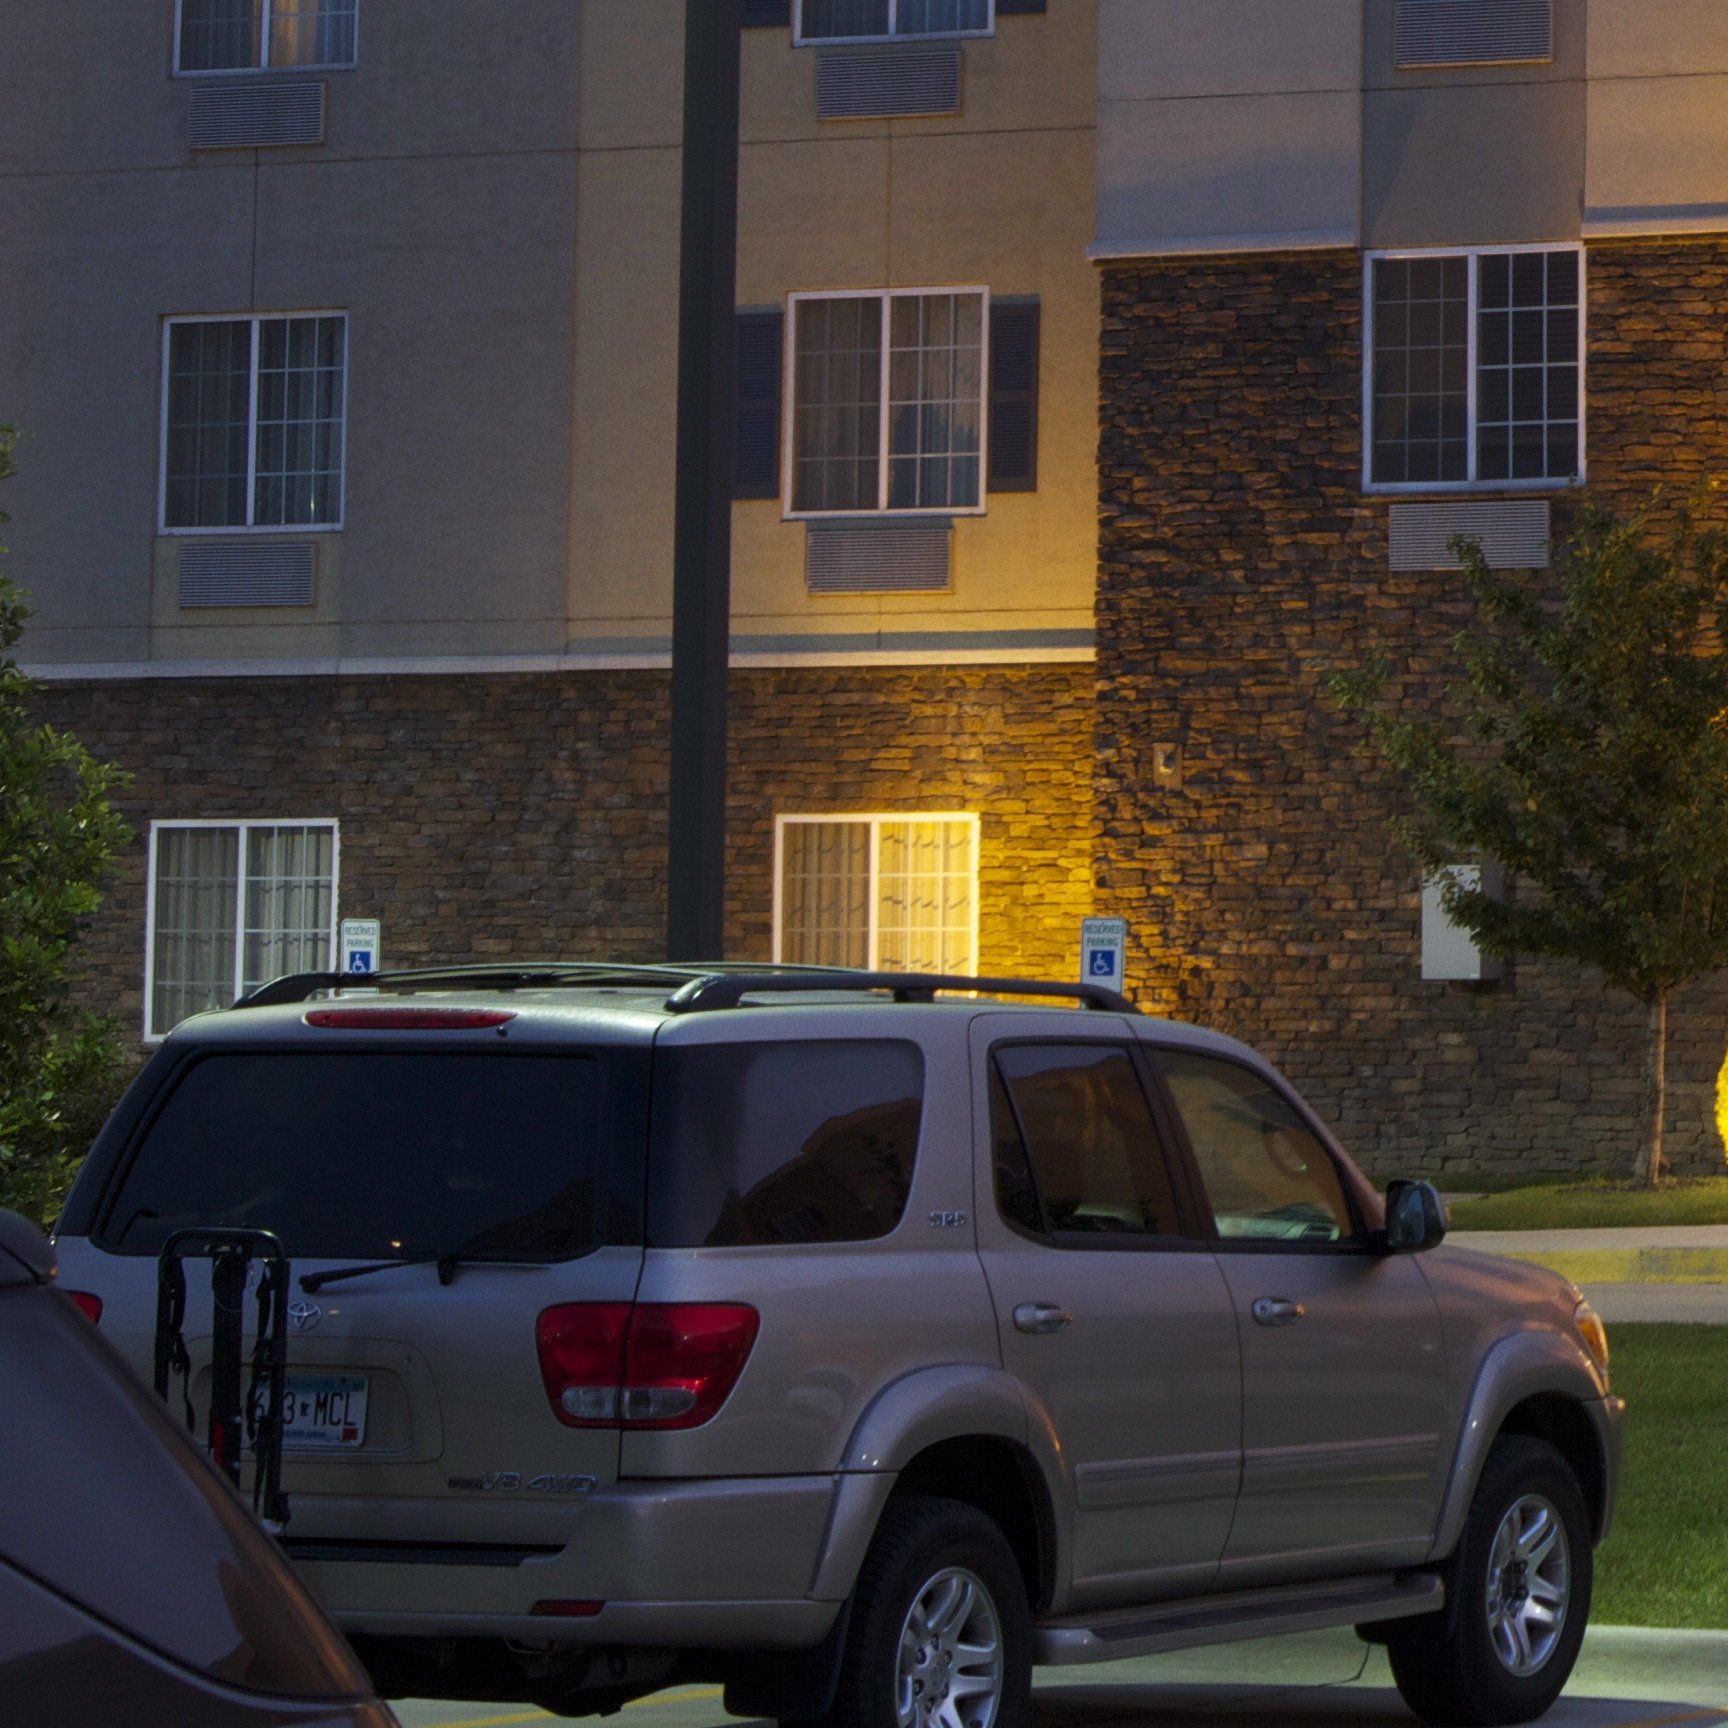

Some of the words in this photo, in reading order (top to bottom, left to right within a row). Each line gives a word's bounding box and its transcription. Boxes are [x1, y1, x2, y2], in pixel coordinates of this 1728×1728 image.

[1084, 924, 1122, 935] RESERVED
[1086, 936, 1119, 947] PARKING
[313, 1392, 357, 1427] MCL
[481, 1470, 521, 1492] V8
[528, 1474, 598, 1493] 4WD
